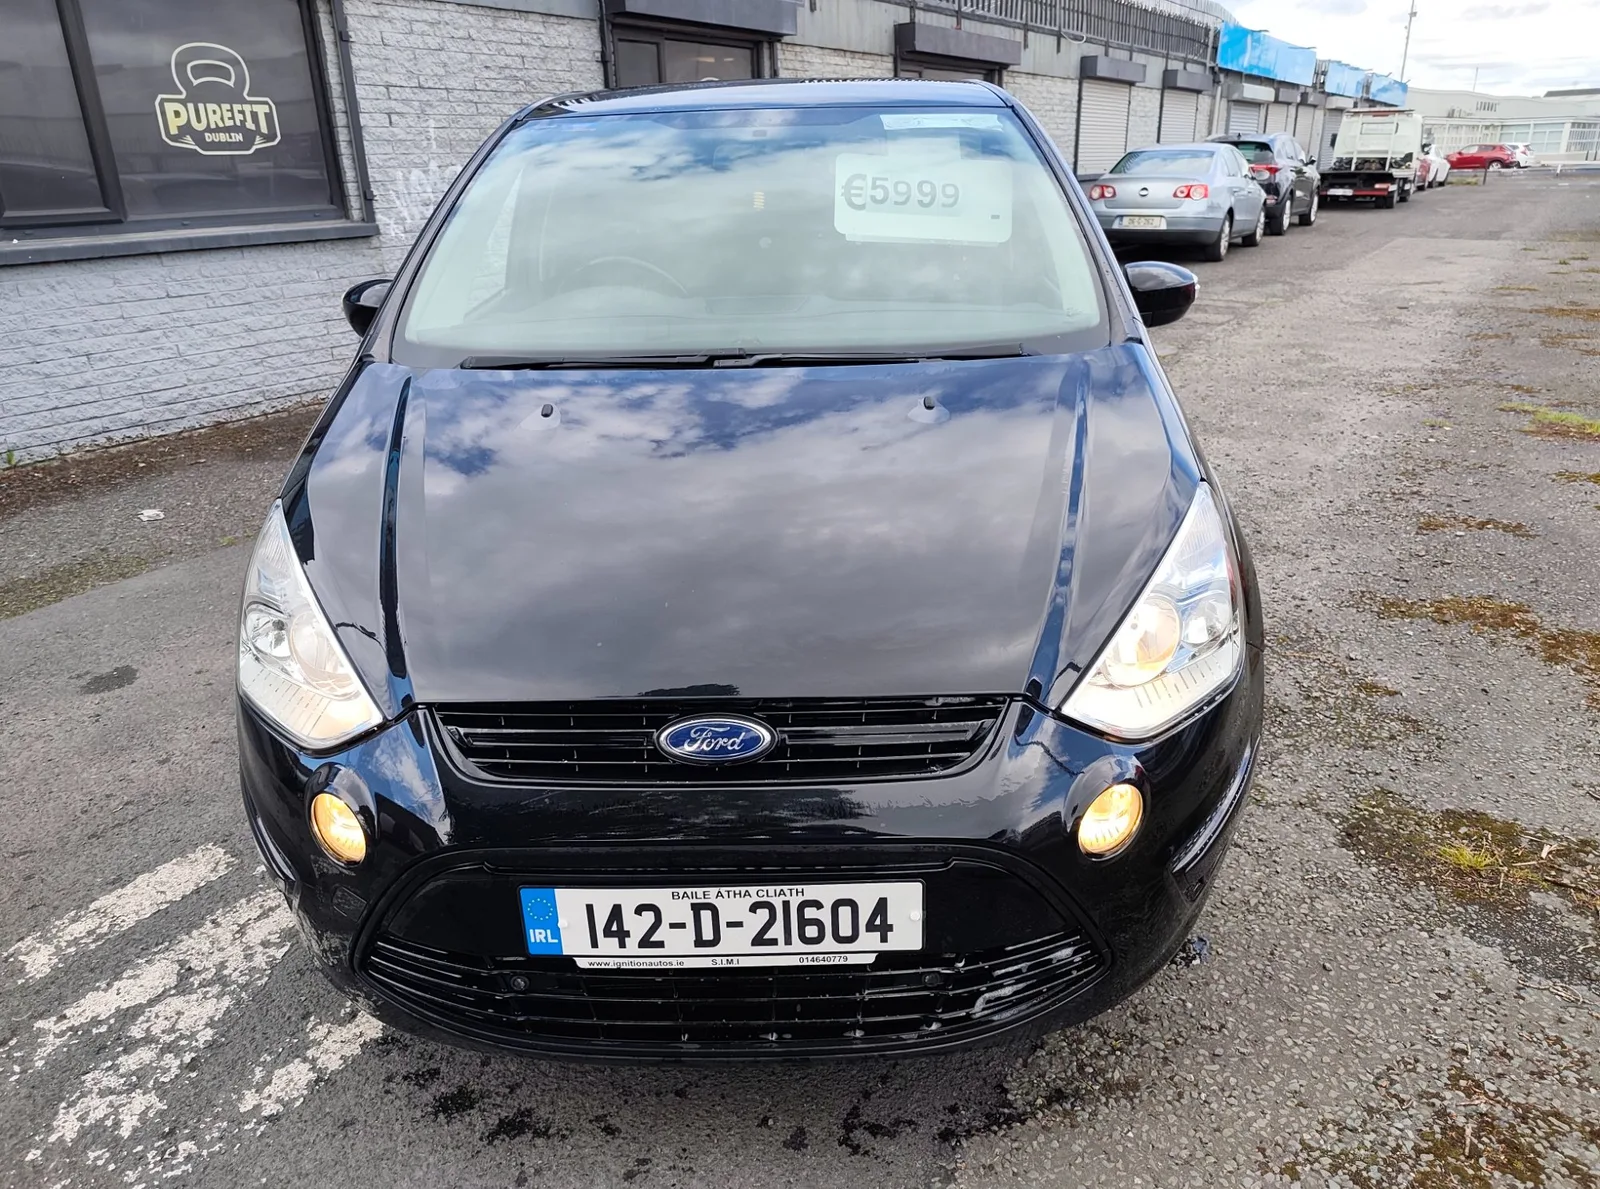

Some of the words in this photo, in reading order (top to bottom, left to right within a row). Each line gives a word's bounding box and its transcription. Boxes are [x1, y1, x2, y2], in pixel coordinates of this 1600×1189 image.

[163, 102, 270, 136] PUREFIT
[204, 132, 244, 143] DUBLIN
[841, 173, 961, 211] €5999
[683, 726, 746, 751] Ford
[671, 890, 711, 900] BAILE
[715, 888, 752, 900] ÁTHA
[756, 887, 805, 898] CLIATH
[585, 896, 894, 949] 142-D-21604
[529, 928, 559, 943] IRL
[587, 959, 685, 968] www.ignitionautos.ie
[798, 955, 849, 964] 014640779
